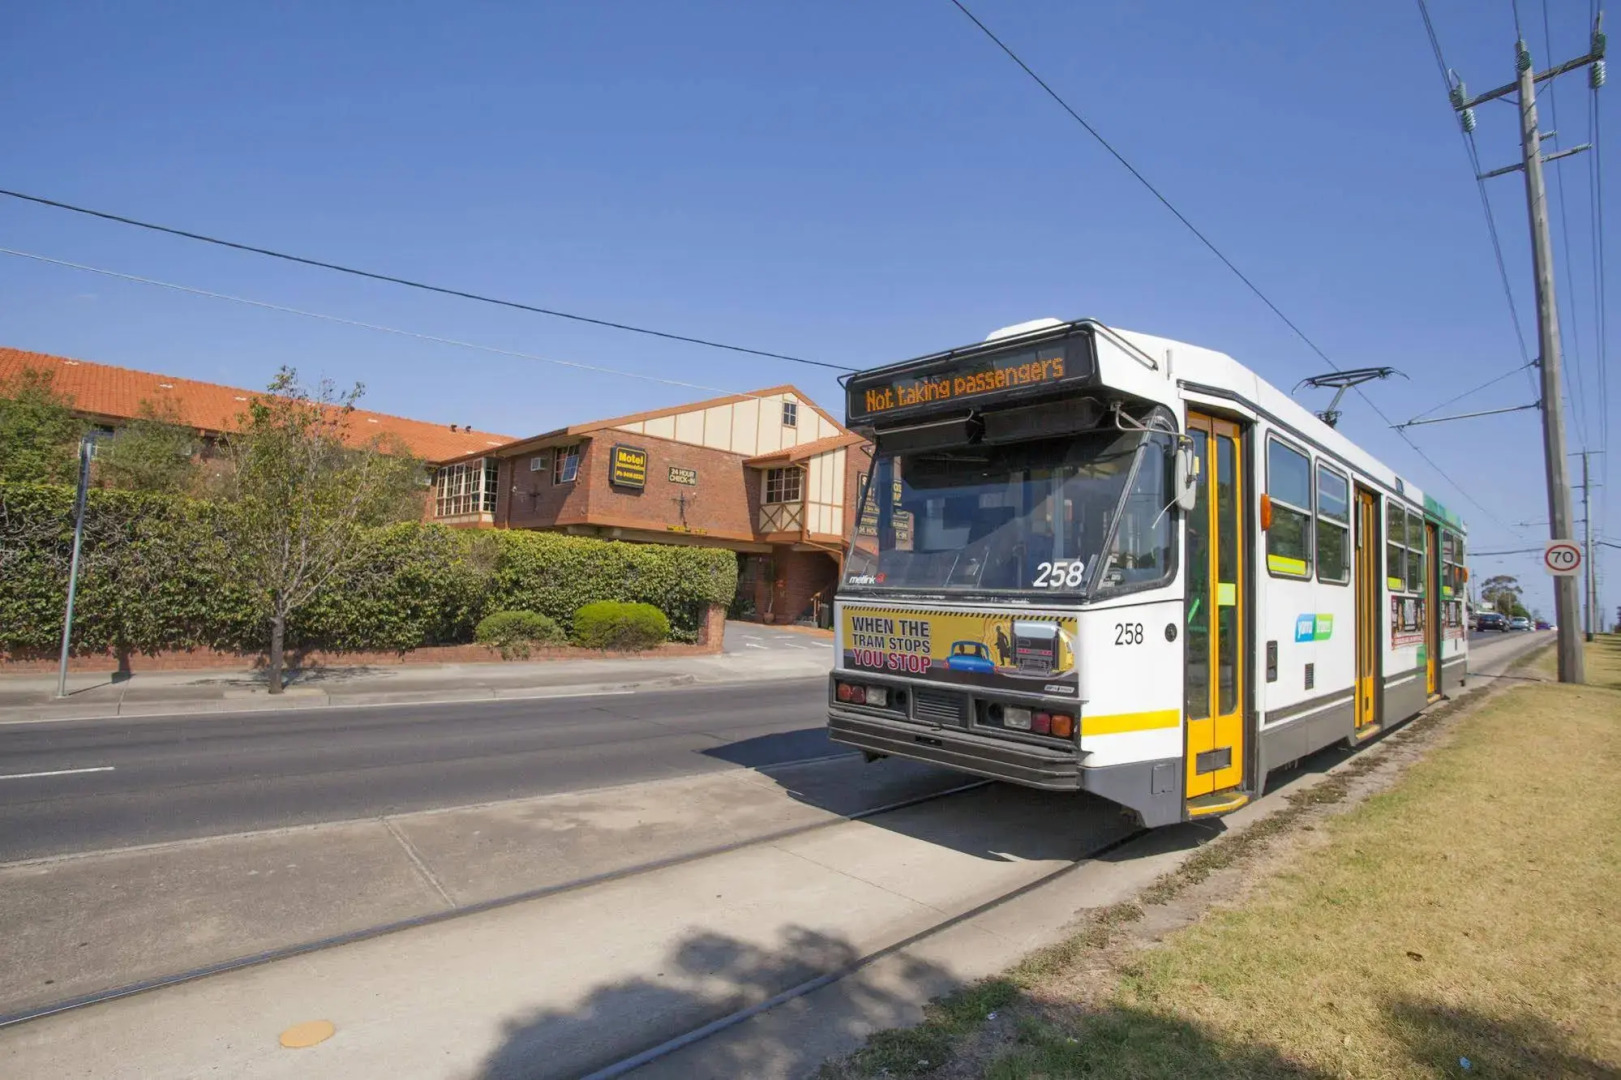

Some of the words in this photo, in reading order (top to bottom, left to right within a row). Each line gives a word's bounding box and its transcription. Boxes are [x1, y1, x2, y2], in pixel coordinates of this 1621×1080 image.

[866, 389, 894, 413] Not
[897, 380, 950, 406] taking
[953, 356, 1065, 396] passengers
[618, 451, 644, 465] Motel
[679, 469, 695, 479] HOUR
[1551, 551, 1574, 563] 70
[1033, 561, 1085, 588] 258
[851, 616, 894, 635] WHEN
[898, 620, 930, 638] THE
[1114, 622, 1144, 646] 258
[852, 633, 885, 649] TRAM
[888, 638, 931, 654] STOPS
[852, 649, 884, 669] YOU
[887, 654, 932, 674] STOP
